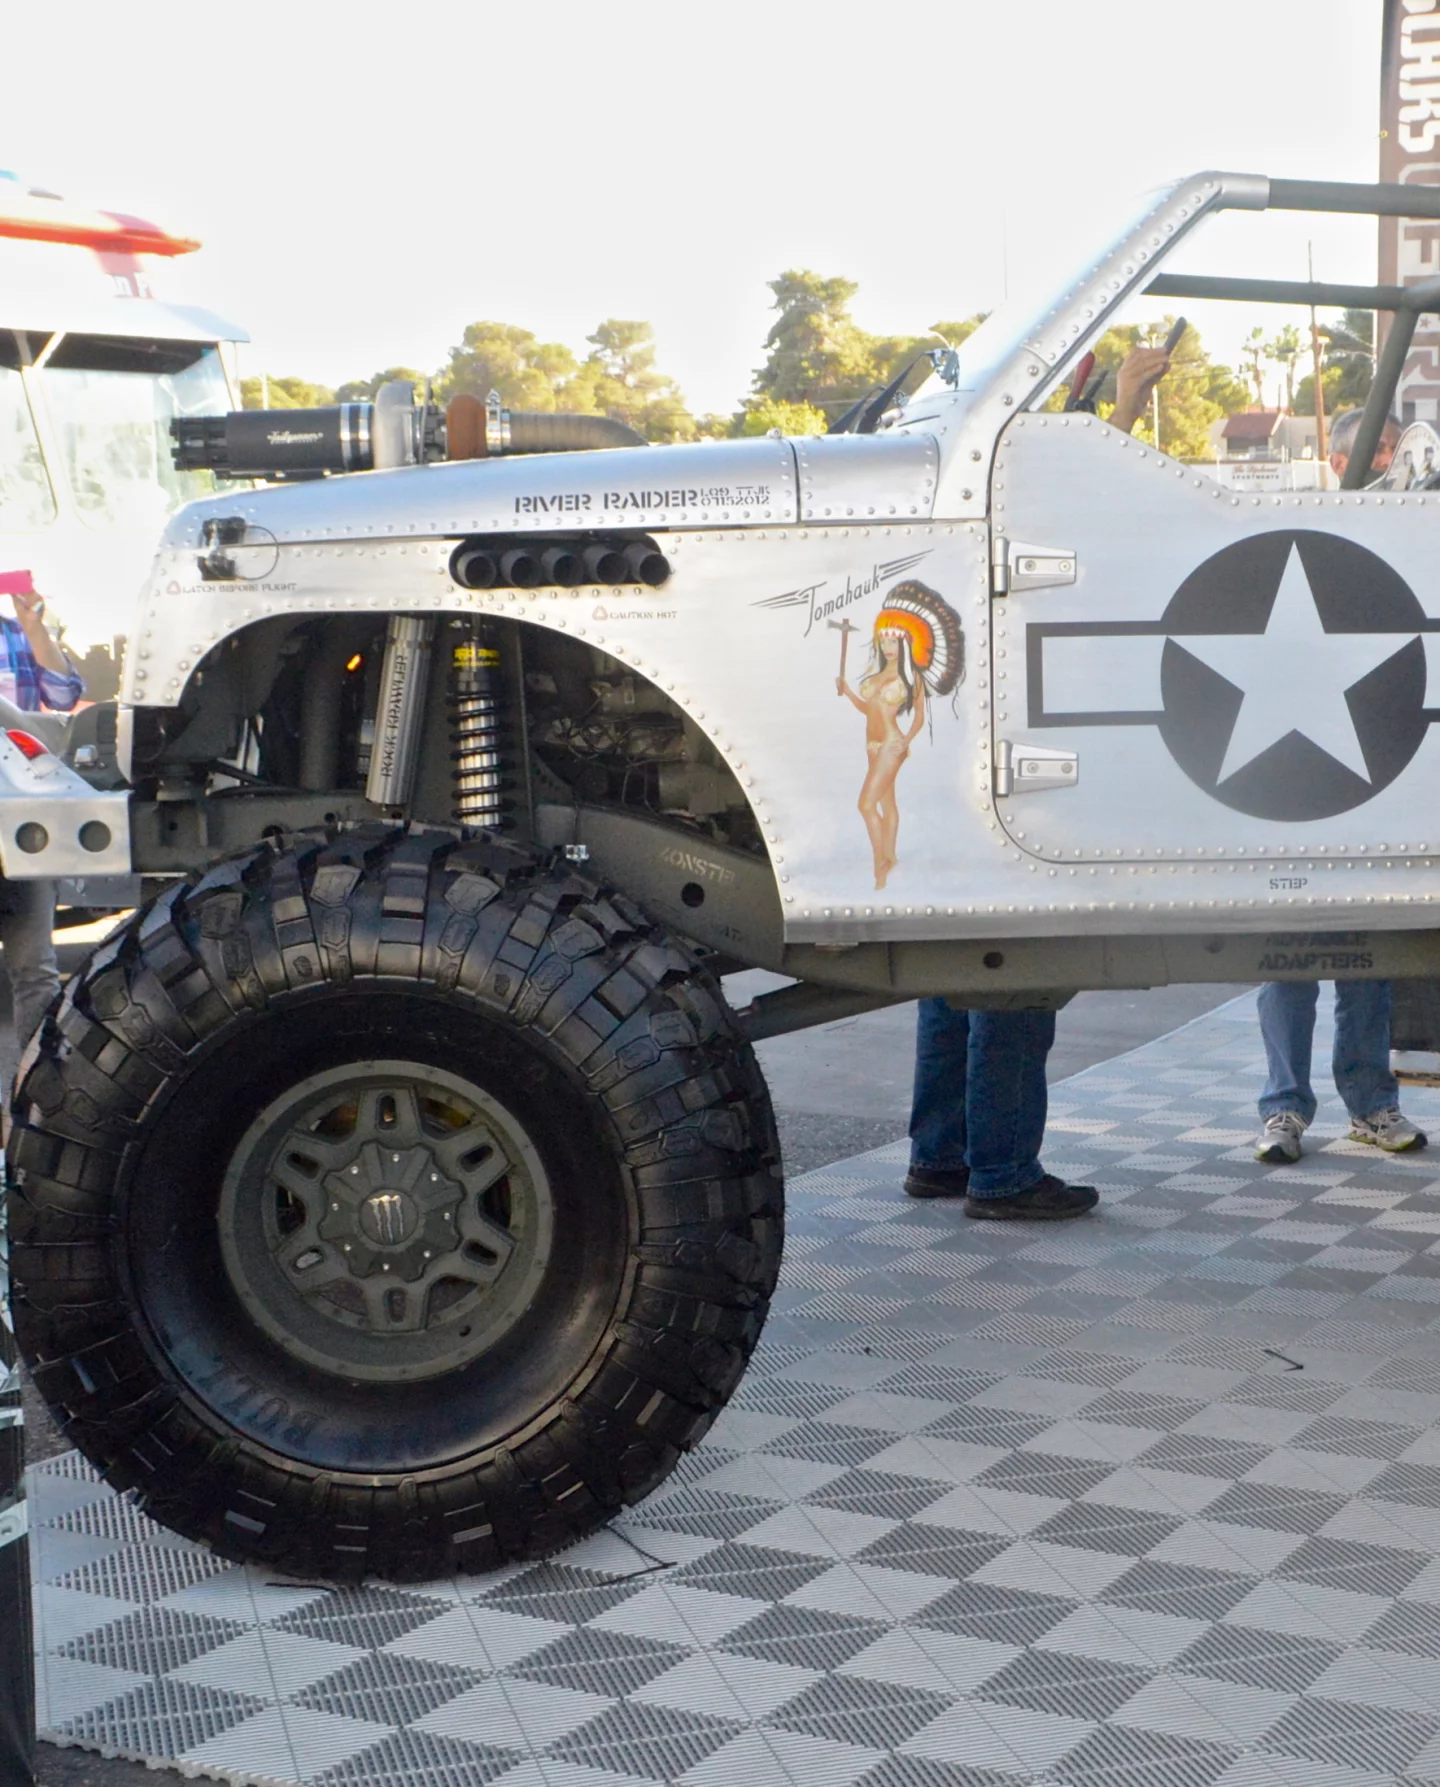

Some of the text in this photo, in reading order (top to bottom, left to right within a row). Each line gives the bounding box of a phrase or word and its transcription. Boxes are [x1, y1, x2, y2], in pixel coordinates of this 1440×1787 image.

[514, 488, 698, 514] RIVER RAIDER
[701, 495, 770, 507] 07152012
[609, 610, 678, 620] CAUTION HOT
[381, 655, 409, 777] ROCK KRAWLER
[1269, 877, 1308, 890] STEP
[1258, 951, 1375, 971] ADAPTERS
